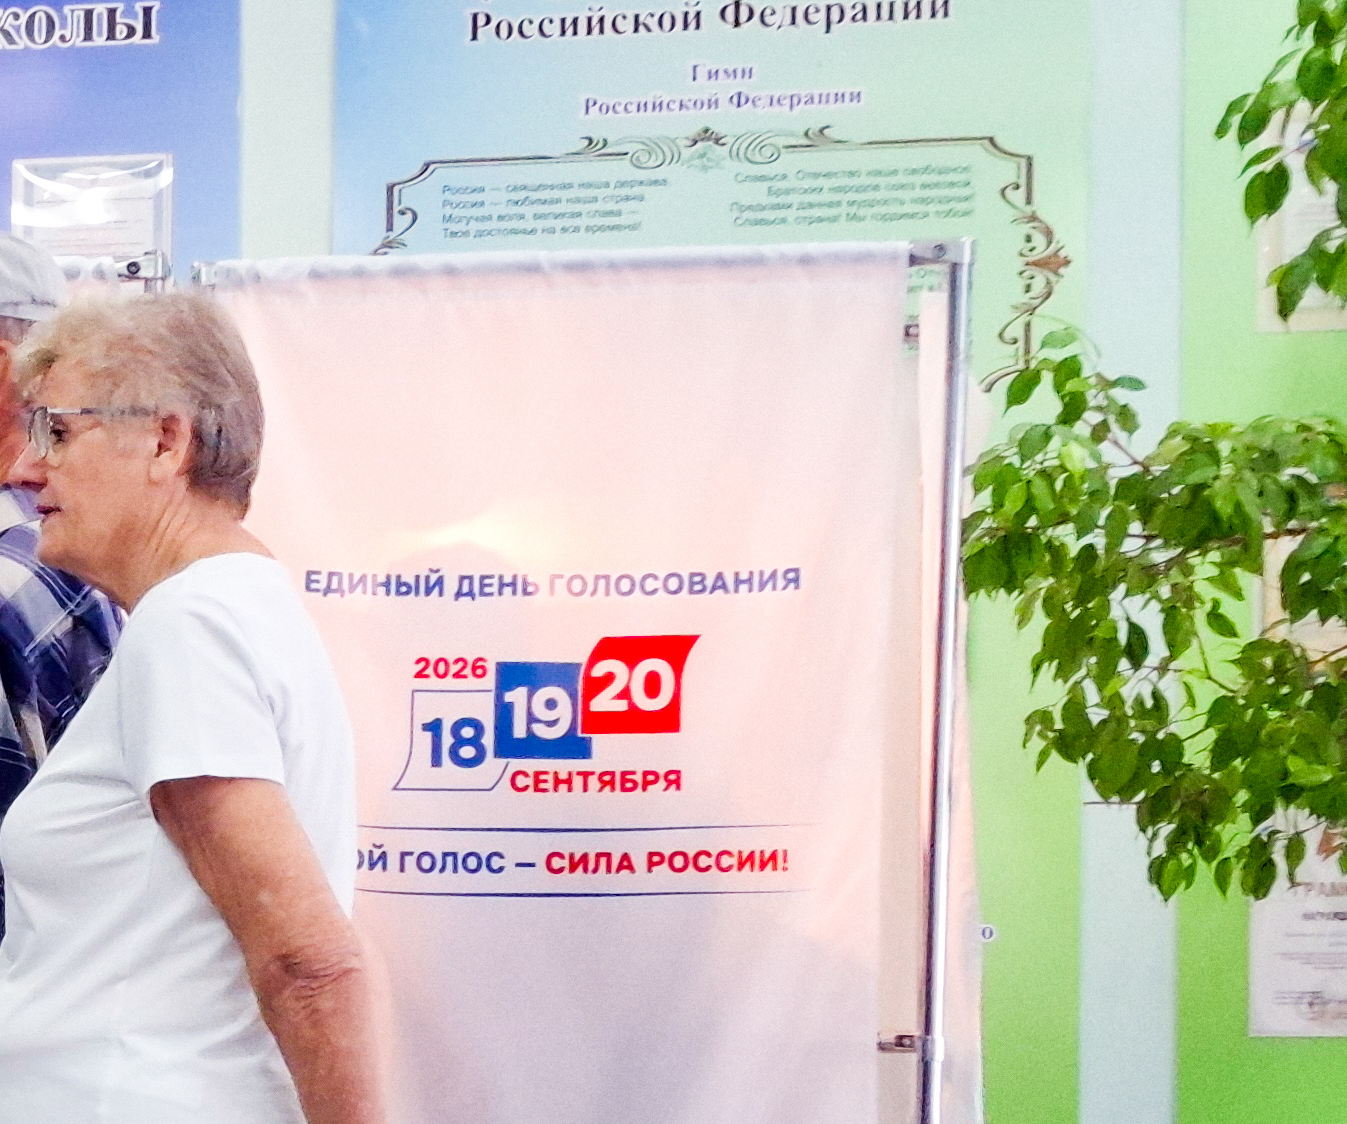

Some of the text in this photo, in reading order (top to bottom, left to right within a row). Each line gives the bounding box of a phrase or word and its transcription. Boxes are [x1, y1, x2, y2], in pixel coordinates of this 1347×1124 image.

[469, 0, 950, 42] Российской Федерации
[584, 88, 862, 116] Российской Федерации
[305, 567, 801, 600] ЕДИНЫЙ ДЕНЬ ГОЛОСОВАНИЯ
[413, 656, 488, 679] 2026
[421, 658, 676, 769] 18 19 20
[510, 769, 682, 793] СЕНТЯБРЯ
[400, 850, 506, 874] ГОЛОС
[545, 850, 636, 875] СИЛА
[646, 849, 790, 874] РОССИИ!
